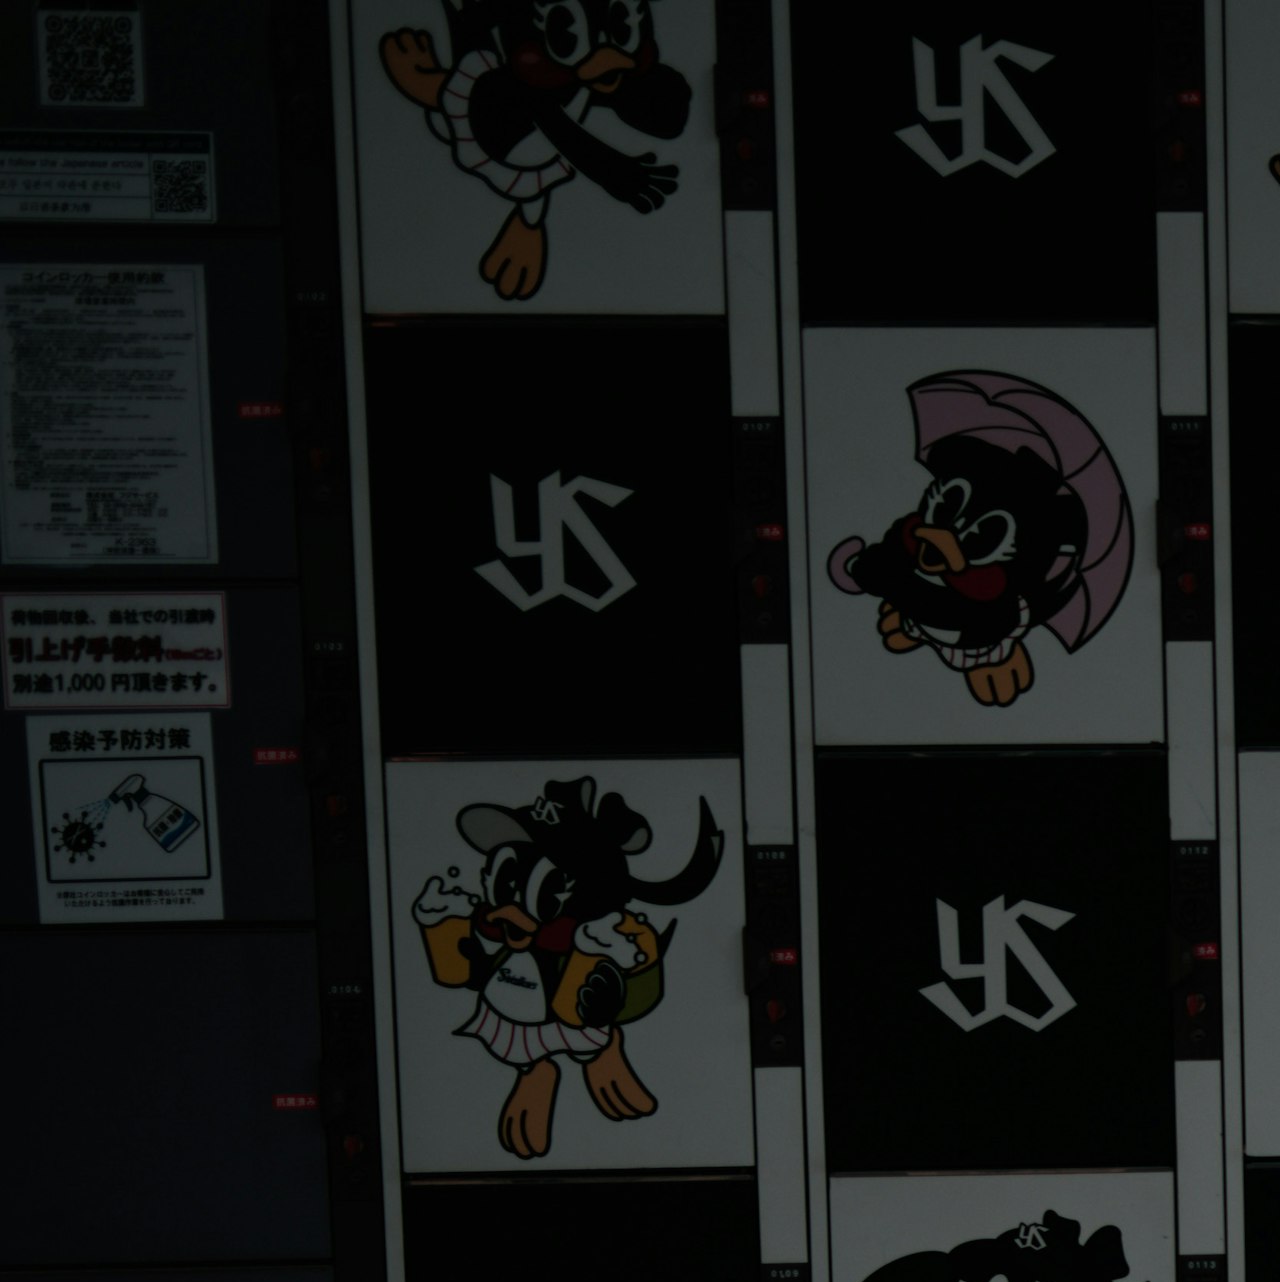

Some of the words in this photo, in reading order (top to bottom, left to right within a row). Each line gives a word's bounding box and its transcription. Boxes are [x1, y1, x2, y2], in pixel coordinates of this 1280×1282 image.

[8, 636, 164, 663] 引上げ手数料
[49, 728, 191, 752] 感染予防対策
